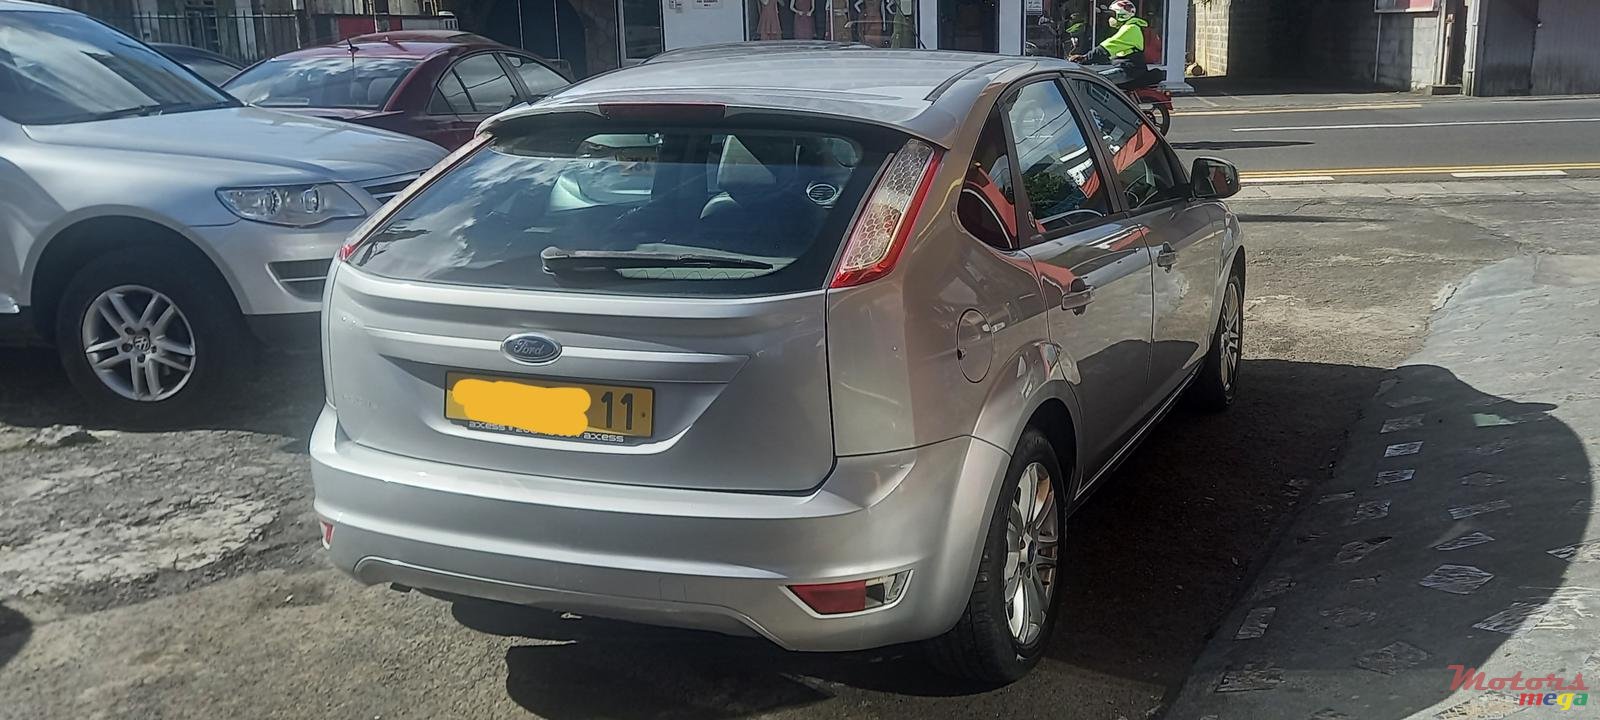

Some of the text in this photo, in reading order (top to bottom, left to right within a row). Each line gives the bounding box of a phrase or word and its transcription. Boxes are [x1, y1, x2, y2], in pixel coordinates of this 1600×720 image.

[512, 338, 546, 354] Ford
[601, 391, 634, 431] 11
[583, 432, 624, 443] axess
